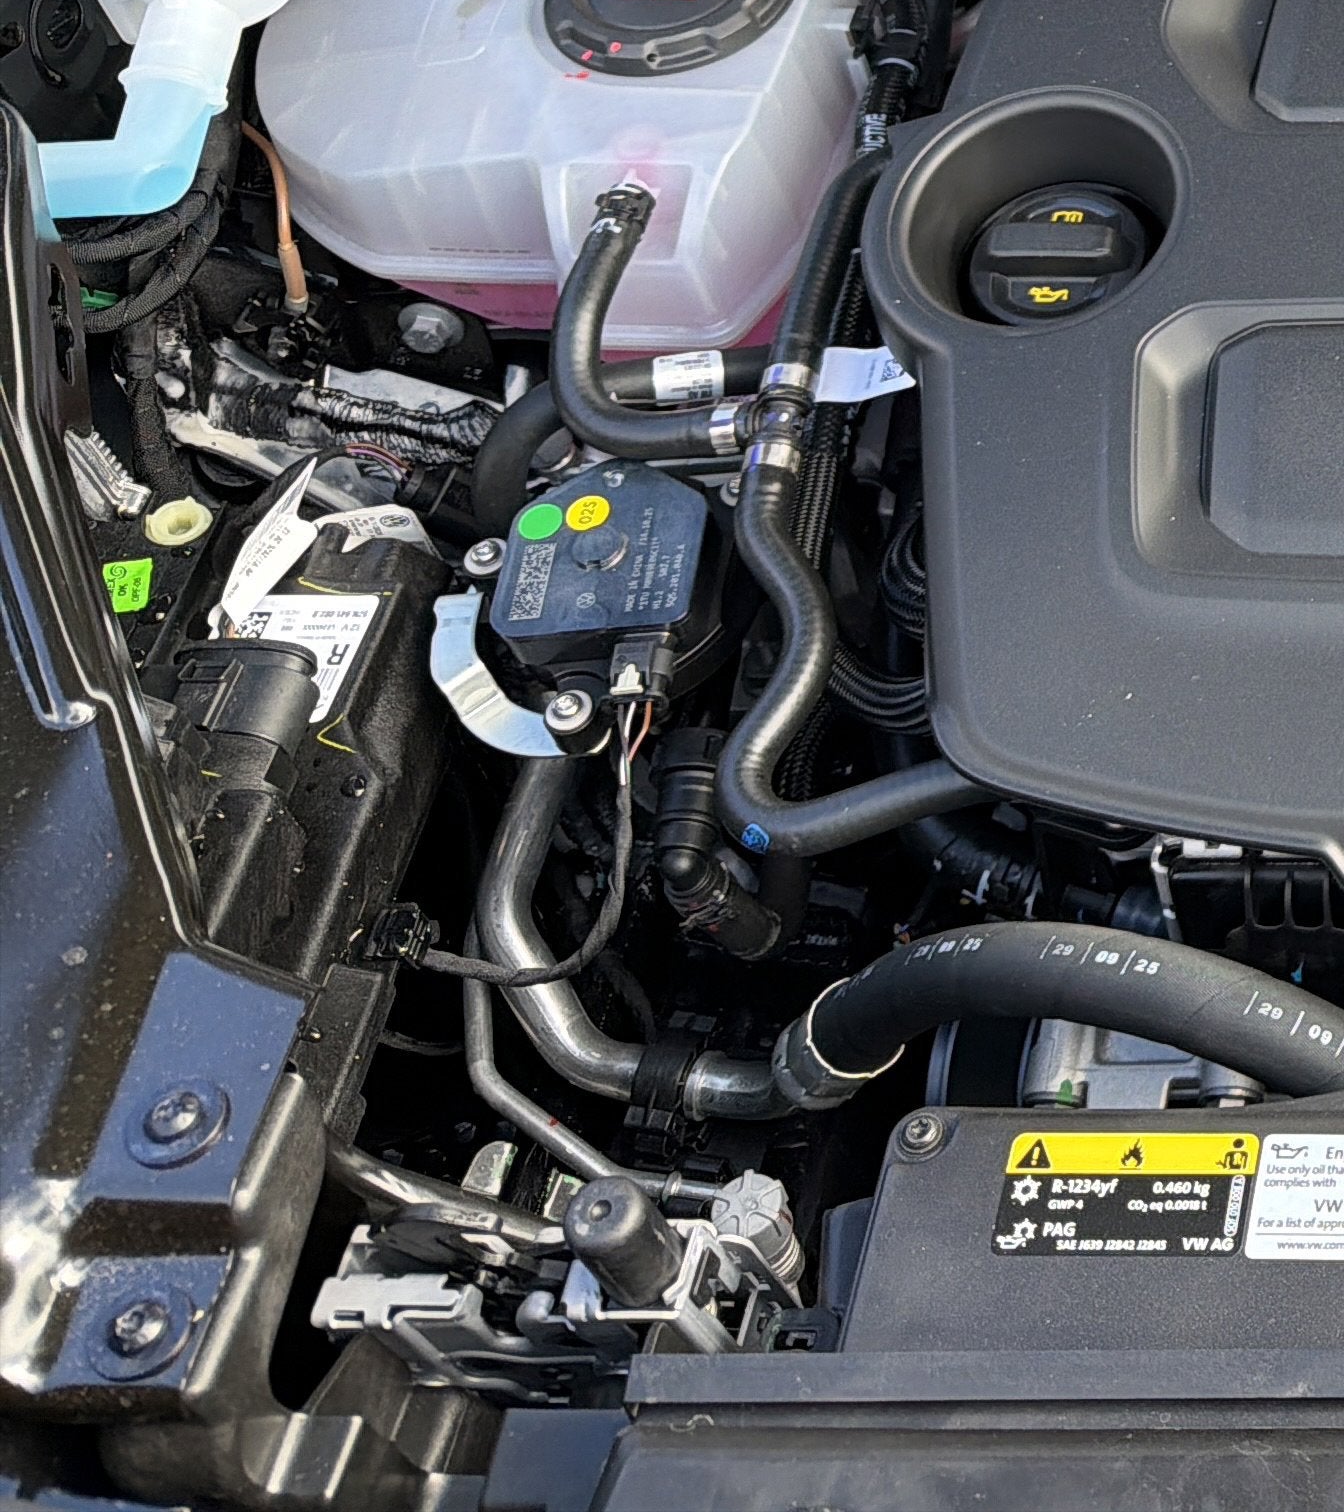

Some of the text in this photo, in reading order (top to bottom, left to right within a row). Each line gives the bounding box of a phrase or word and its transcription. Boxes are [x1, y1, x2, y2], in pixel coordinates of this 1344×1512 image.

[327, 644, 350, 665] R
[1266, 1164, 1287, 1175] Use
[1288, 1164, 1311, 1177] only
[1312, 1165, 1326, 1175] oil
[1052, 1178, 1211, 1197] R-1234yf 0.460 kg
[1264, 1178, 1336, 1190] complies with
[1047, 1199, 1075, 1210] GWP
[1314, 1199, 1343, 1213] VW
[1257, 1217, 1274, 1228] For
[1286, 1217, 1301, 1228] list
[1304, 1217, 1316, 1228] of
[1042, 1222, 1077, 1238] PAG
[1056, 1239, 1077, 1251] SAE
[1182, 1237, 1208, 1251] VW
[1210, 1238, 1234, 1251] AG
